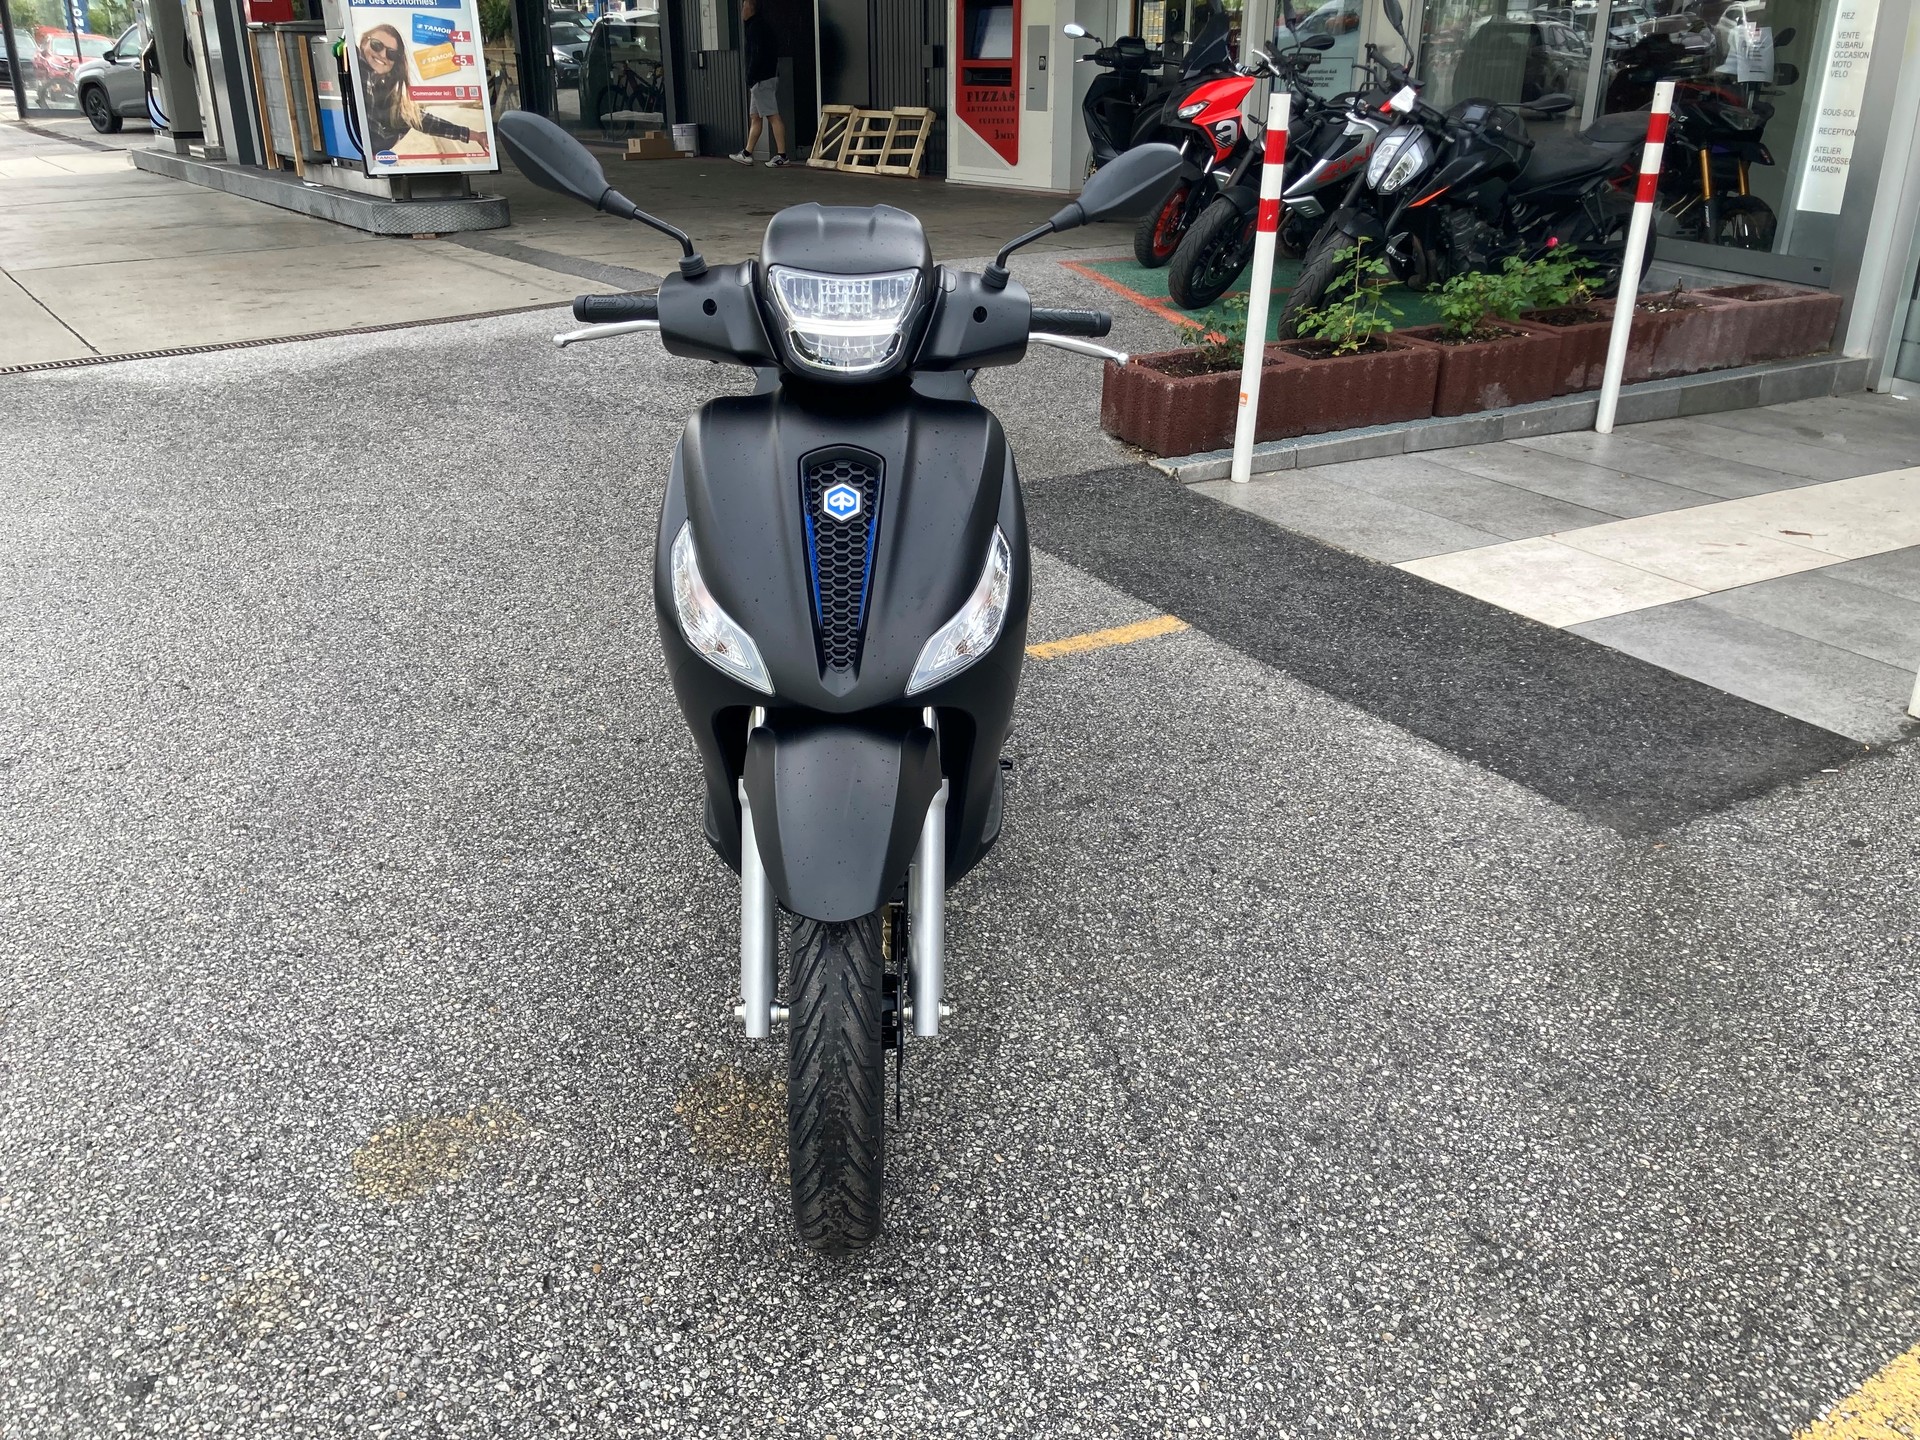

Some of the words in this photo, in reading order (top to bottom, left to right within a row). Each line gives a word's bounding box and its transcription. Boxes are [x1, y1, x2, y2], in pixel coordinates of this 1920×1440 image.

[1841, 12, 1855, 20] REZ
[1836, 41, 1864, 49] SUBARU
[1834, 51, 1870, 59] OCCASION
[1831, 70, 1848, 78] VELO
[966, 90, 1016, 102] PIZZAS
[1822, 108, 1857, 118] SOUS-SOL
[1818, 127, 1857, 137] RECEPTION
[1815, 146, 1841, 155] ATELIER
[1811, 165, 1841, 174] MAGASIN
